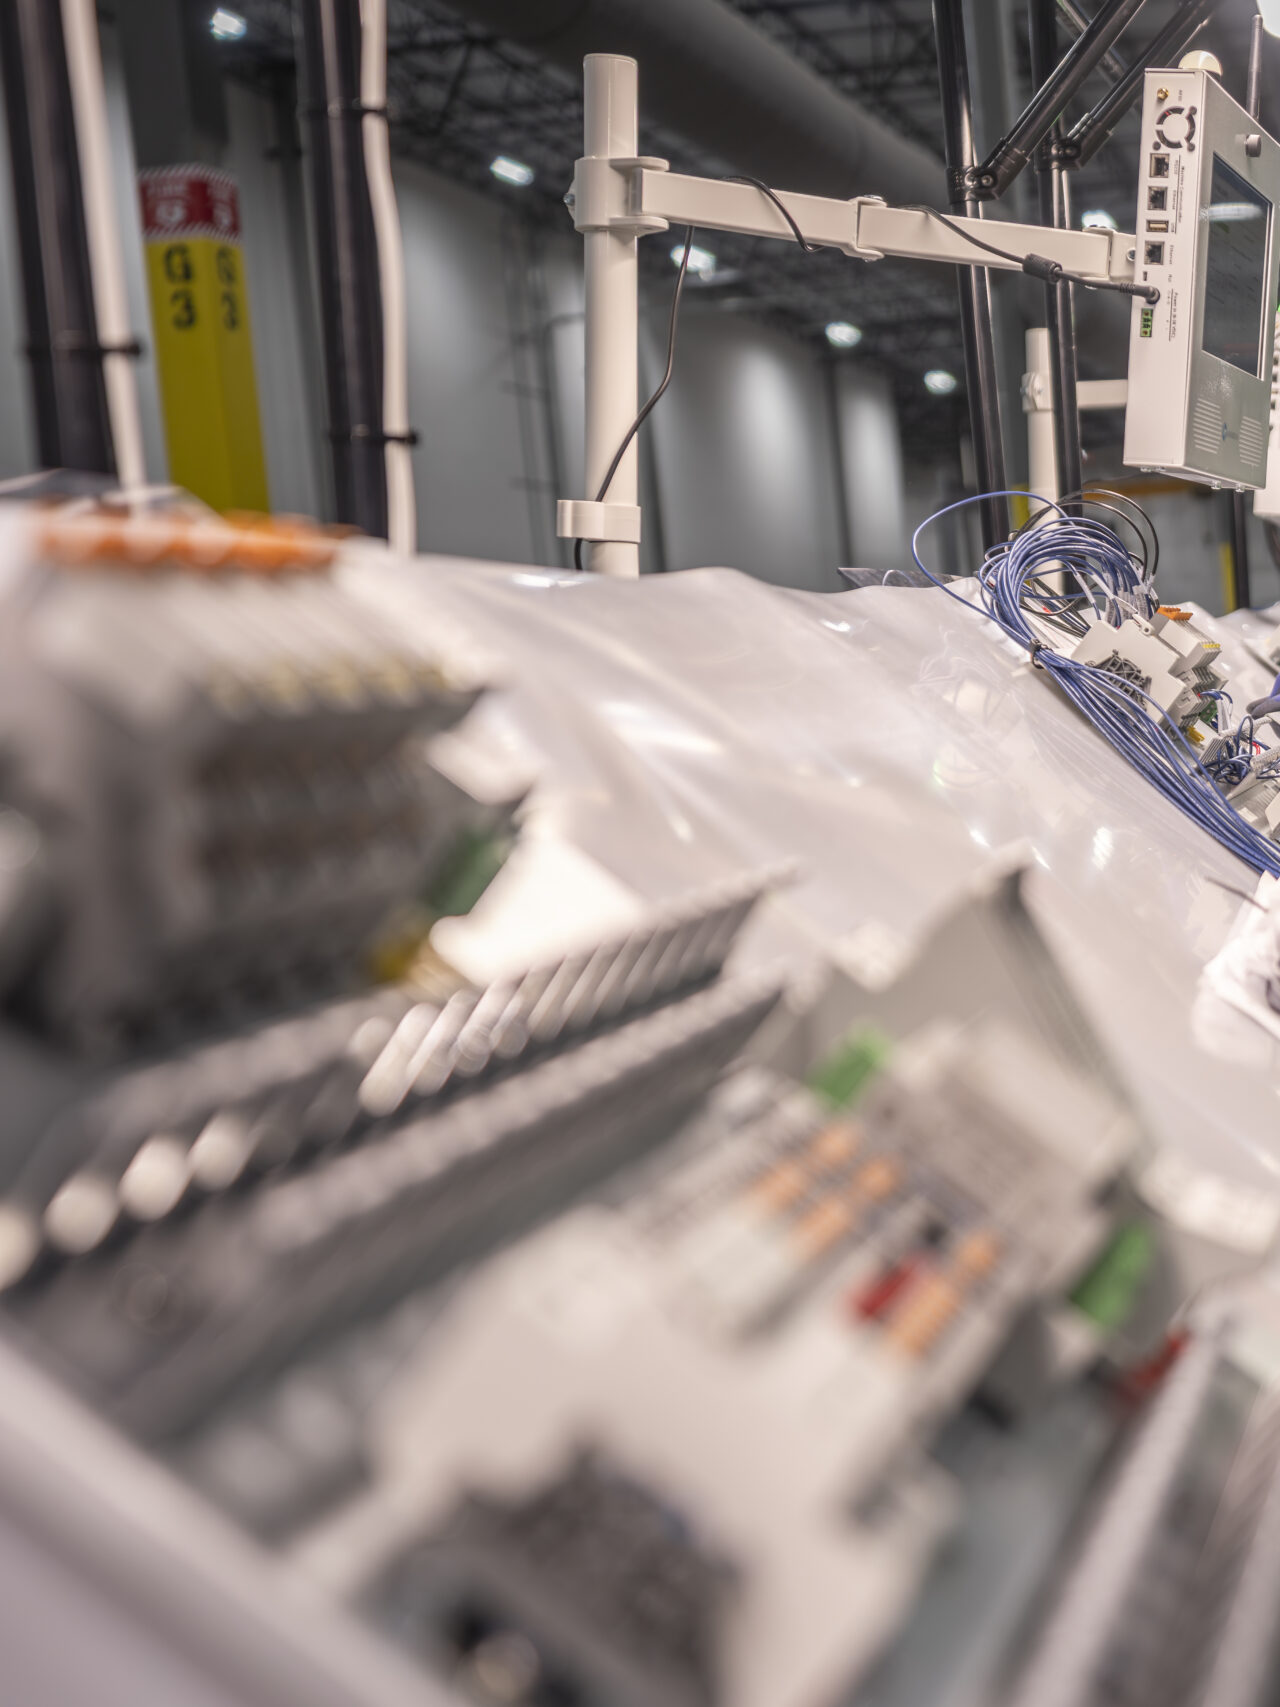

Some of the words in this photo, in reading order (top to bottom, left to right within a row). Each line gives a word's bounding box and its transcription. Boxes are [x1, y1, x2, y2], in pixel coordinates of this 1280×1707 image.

[163, 244, 193, 284] G
[215, 246, 238, 286] G
[170, 289, 197, 331] 3
[220, 290, 240, 331] 3
